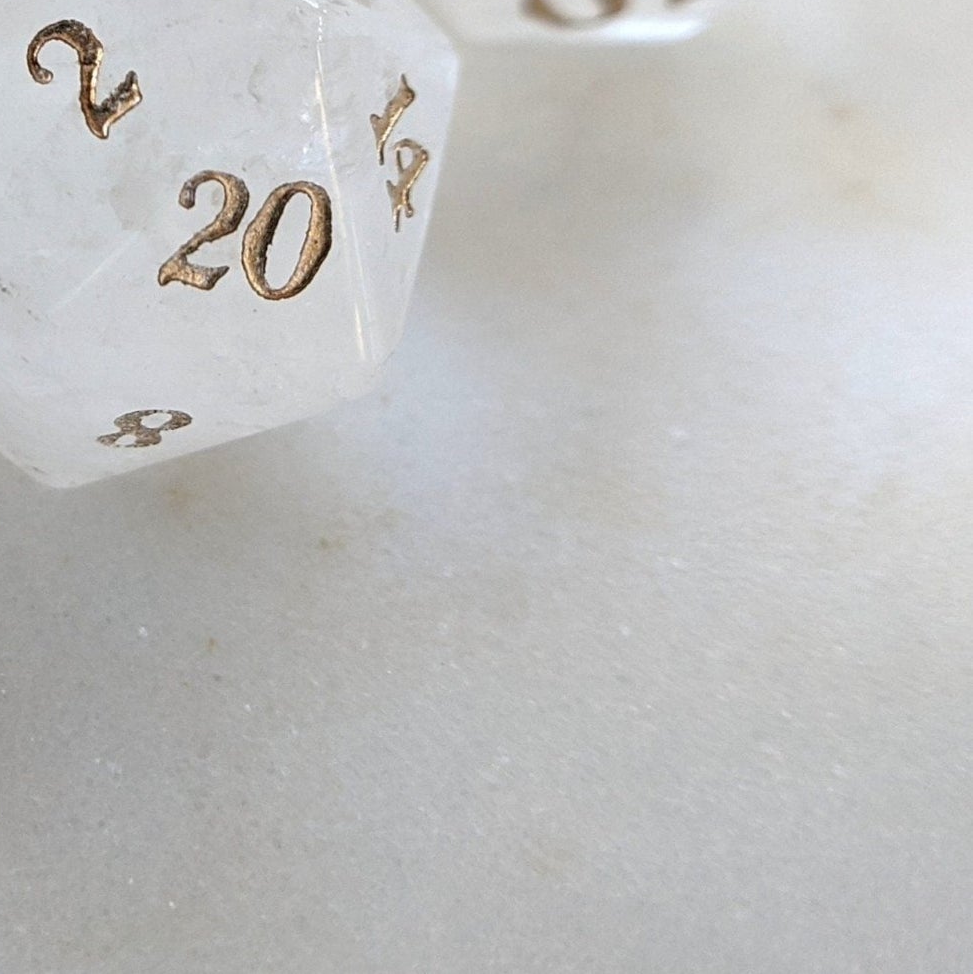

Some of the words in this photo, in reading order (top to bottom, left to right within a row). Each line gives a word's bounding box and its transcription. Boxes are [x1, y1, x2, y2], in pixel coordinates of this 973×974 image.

[27, 20, 143, 139] 2
[157, 170, 332, 301] 20
[97, 409, 193, 448] 8
